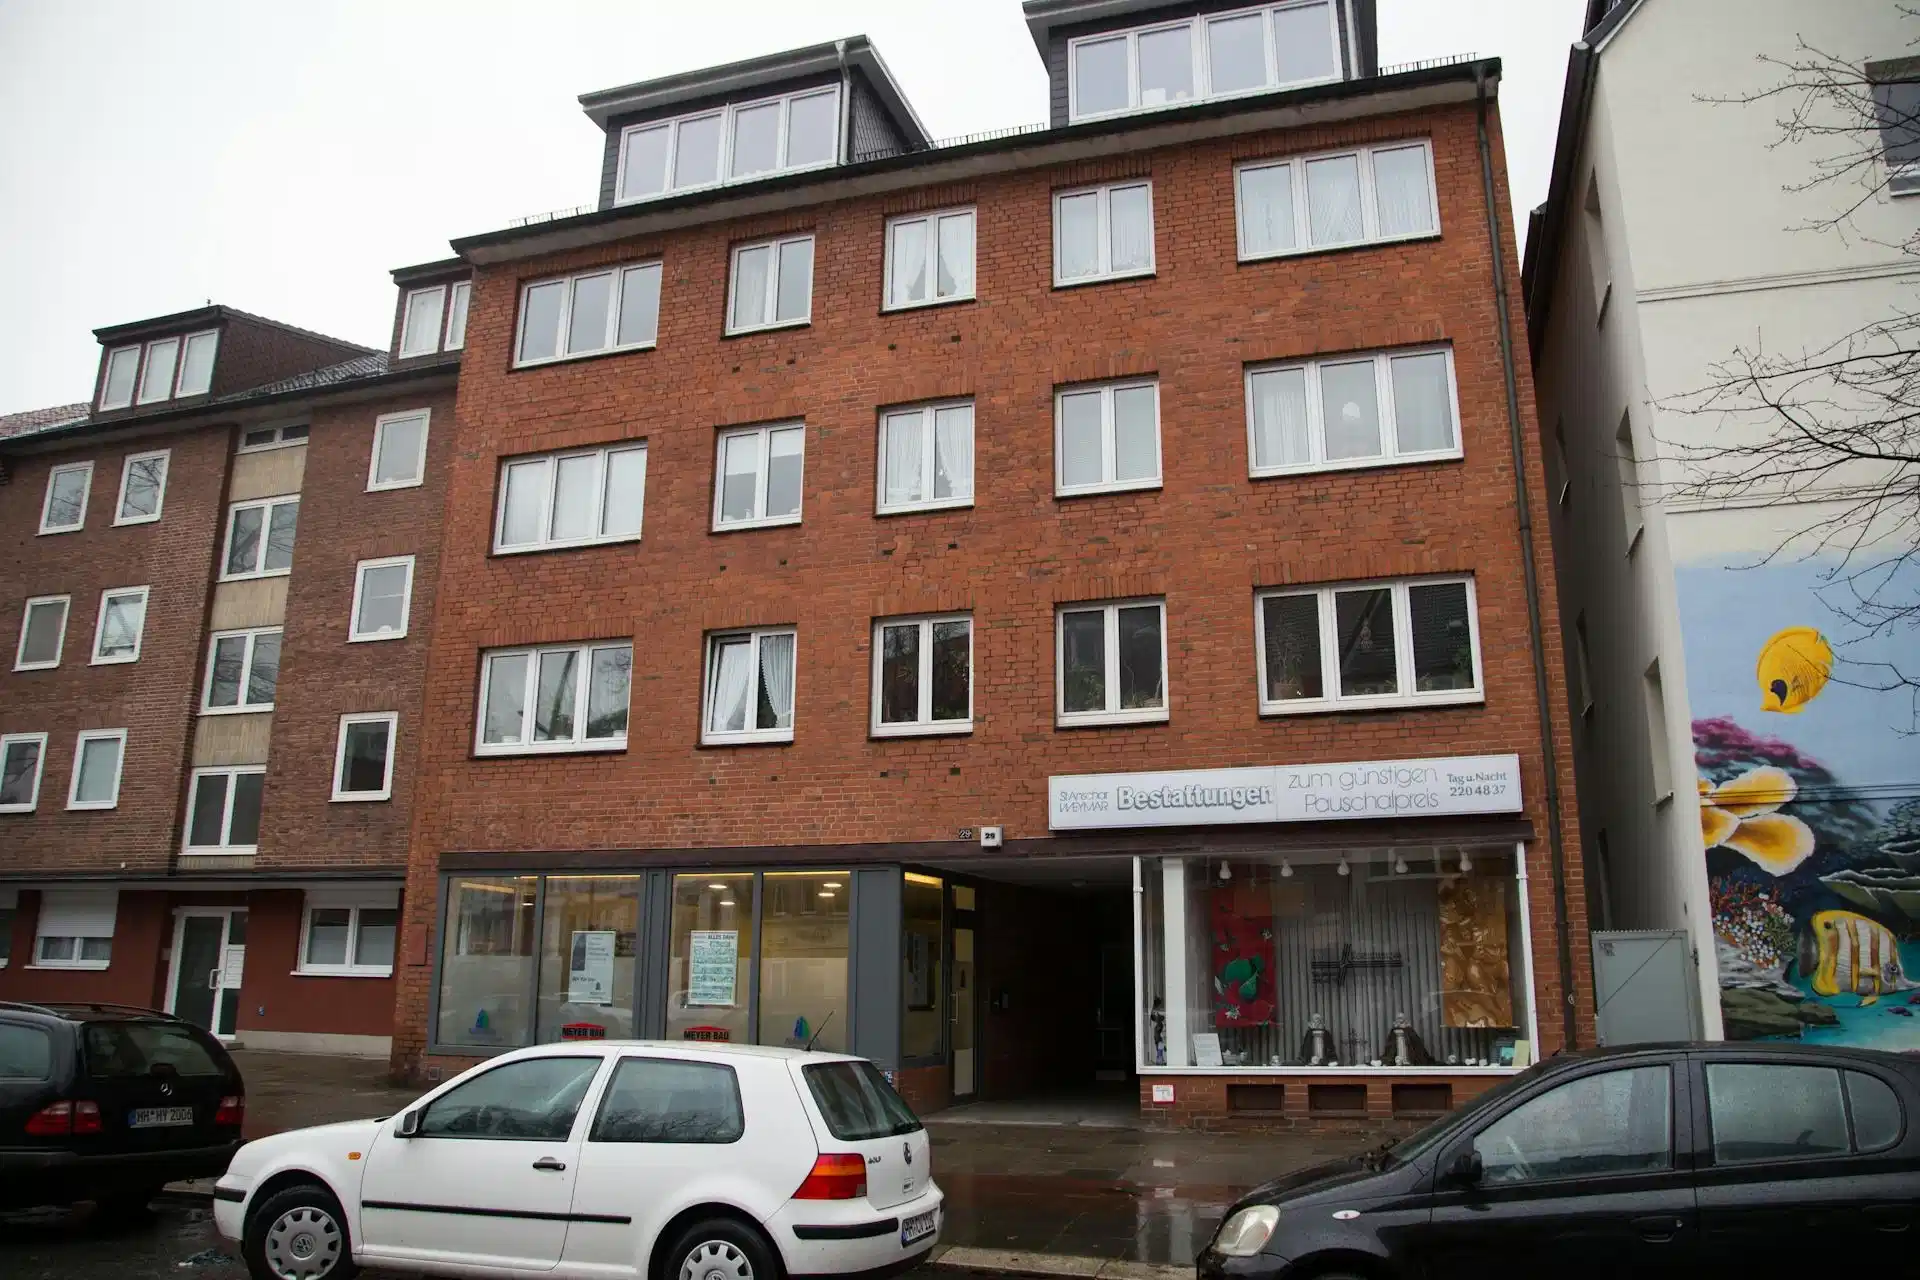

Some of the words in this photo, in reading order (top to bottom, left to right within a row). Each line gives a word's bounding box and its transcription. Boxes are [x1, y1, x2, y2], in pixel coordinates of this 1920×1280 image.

[1288, 772, 1333, 789] zum
[1339, 766, 1438, 791] günstigen
[1446, 773, 1465, 785] Tag
[1117, 784, 1273, 811] Bestattungen
[1305, 788, 1439, 814] Pauschalpreis
[984, 832, 996, 840] 29
[562, 1028, 588, 1037] MEYER
[684, 1030, 711, 1040] MEYER
[713, 1030, 729, 1040] BAU
